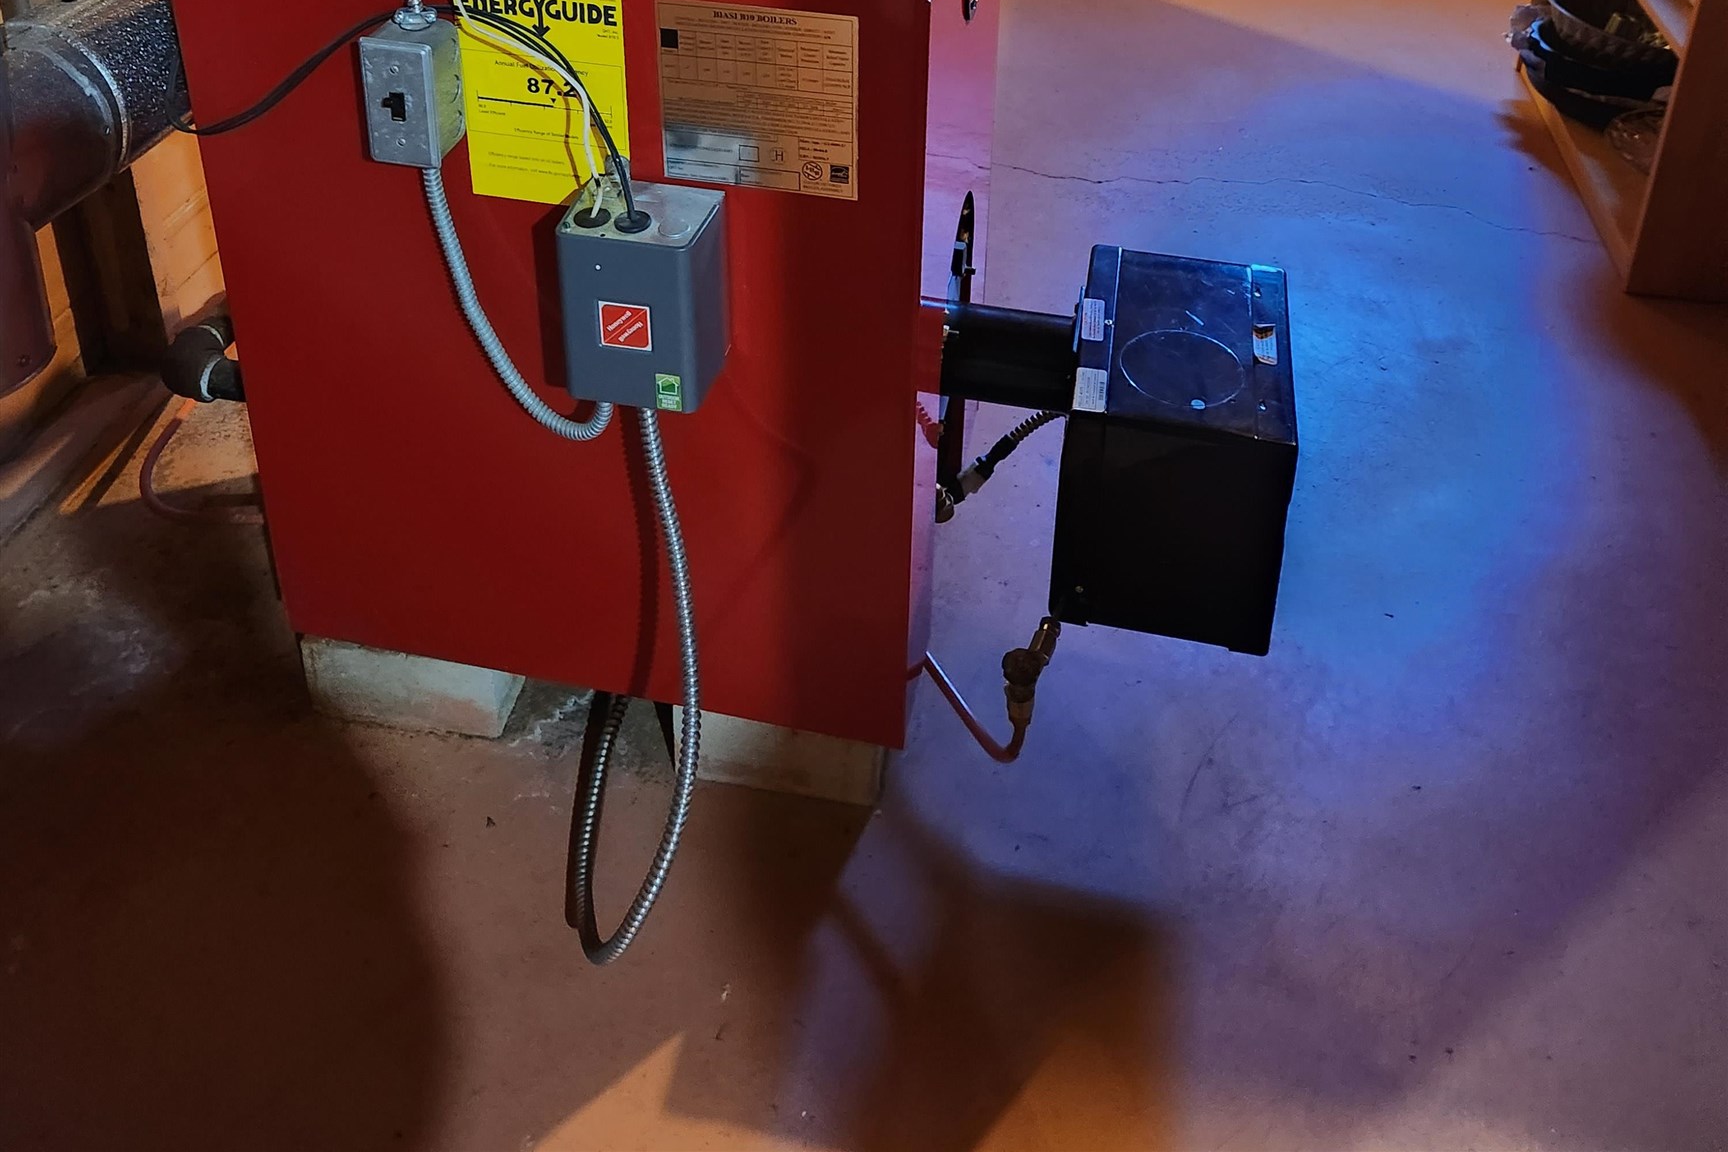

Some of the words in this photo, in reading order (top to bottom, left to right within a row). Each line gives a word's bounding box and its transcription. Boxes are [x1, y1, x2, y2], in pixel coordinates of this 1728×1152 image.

[713, 10, 738, 19] BIASI
[757, 15, 798, 25] BOILERS
[527, 77, 578, 98] 87.2
[775, 150, 784, 162] H
[606, 310, 632, 332] Honeywell
[618, 321, 644, 343] Honeywell
